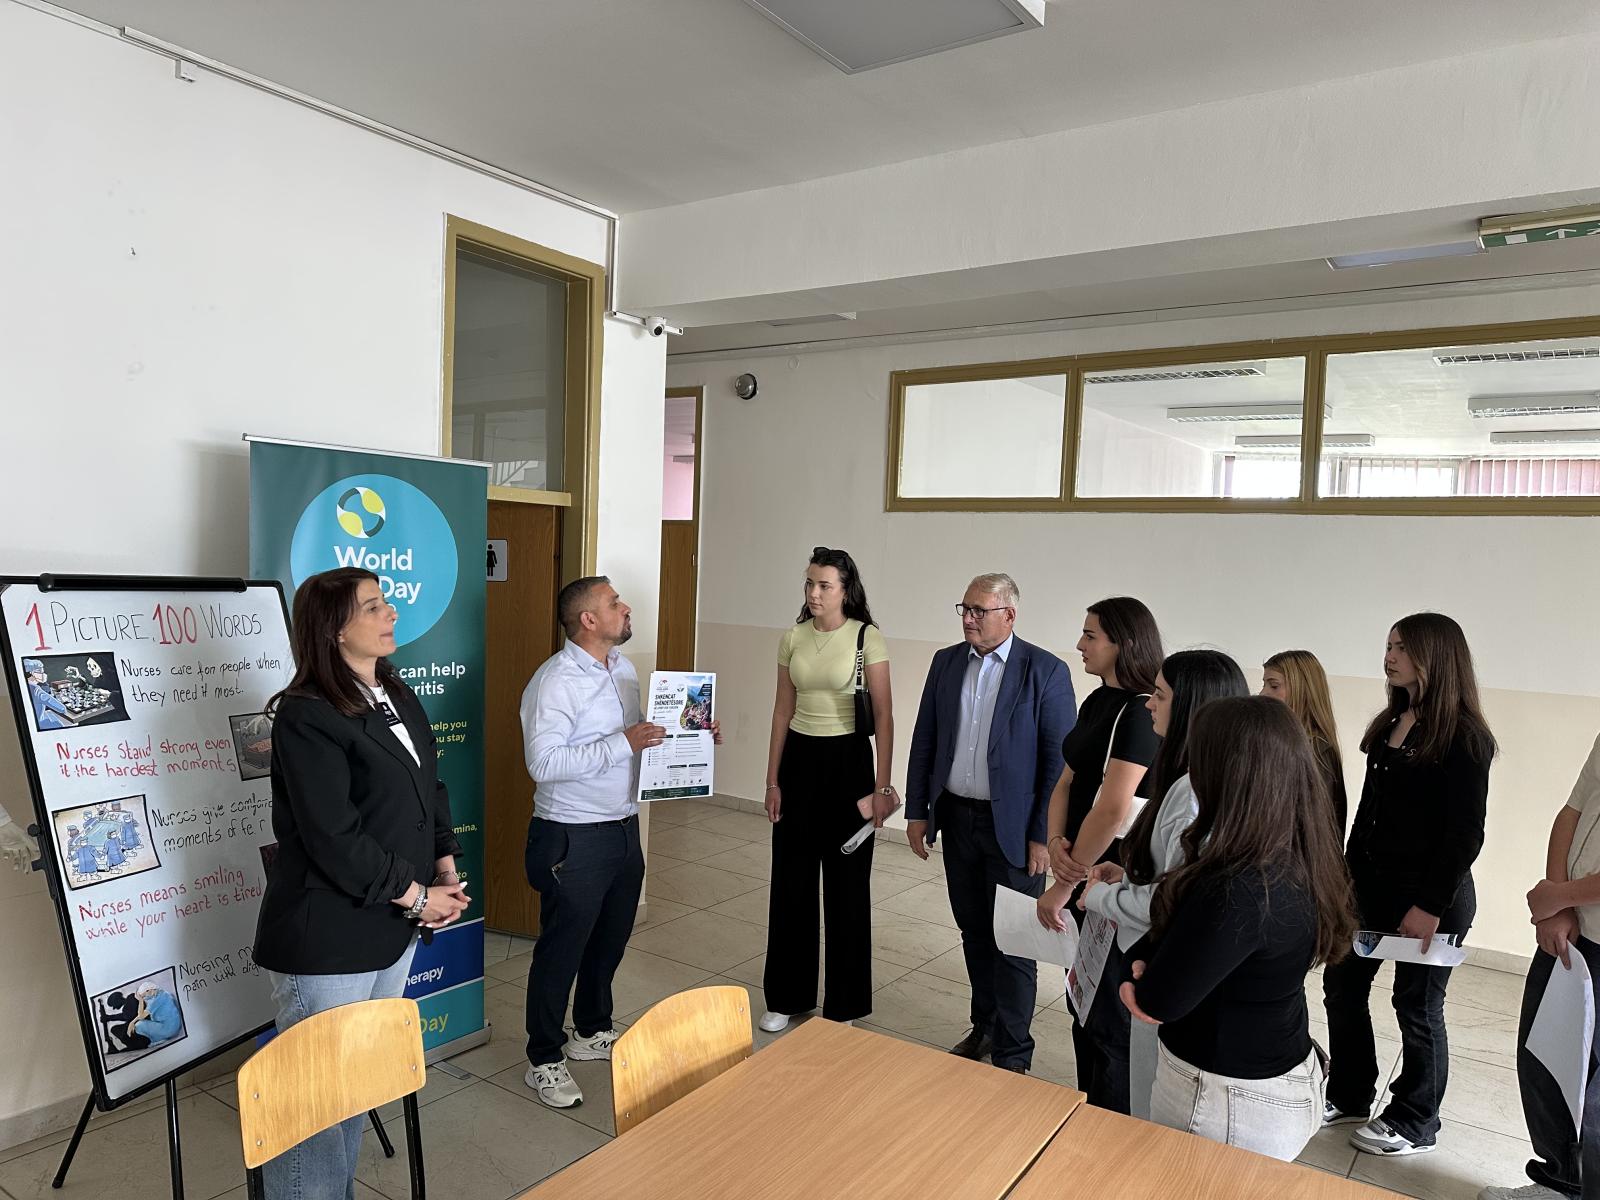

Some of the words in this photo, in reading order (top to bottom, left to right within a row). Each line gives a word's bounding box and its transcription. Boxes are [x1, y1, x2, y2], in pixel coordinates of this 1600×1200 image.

[333, 545, 413, 571] World
[378, 575, 422, 605] Day
[25, 603, 52, 651] 1
[153, 603, 197, 645] 100
[121, 658, 162, 678] Nurses
[171, 665, 192, 675] care
[197, 660, 216, 681] for
[220, 657, 251, 680] people
[256, 651, 281, 670] when
[399, 666, 427, 679] can
[431, 661, 466, 679] help
[132, 685, 166, 707] they
[173, 683, 198, 704] need
[201, 683, 208, 698] it
[409, 680, 445, 696] ritis
[450, 721, 467, 731] you
[56, 742, 109, 760] Nurses
[160, 738, 201, 760] strong
[204, 738, 231, 750] even
[447, 734, 466, 743] stay
[74, 763, 98, 778] the
[105, 761, 159, 778] hardest
[167, 754, 237, 773] moments
[151, 808, 197, 828] Nurses
[202, 804, 225, 824] give
[163, 826, 222, 853] moments
[227, 818, 237, 838] of
[452, 824, 478, 834] mina,
[78, 898, 132, 921] Nurses
[139, 883, 186, 907] means
[194, 864, 244, 890] smiling
[85, 918, 128, 940] while
[135, 911, 167, 938] your
[174, 896, 212, 919] heart
[217, 893, 229, 905] is
[233, 877, 262, 903] tired
[179, 953, 234, 980] Nursing
[183, 978, 208, 1002] pain
